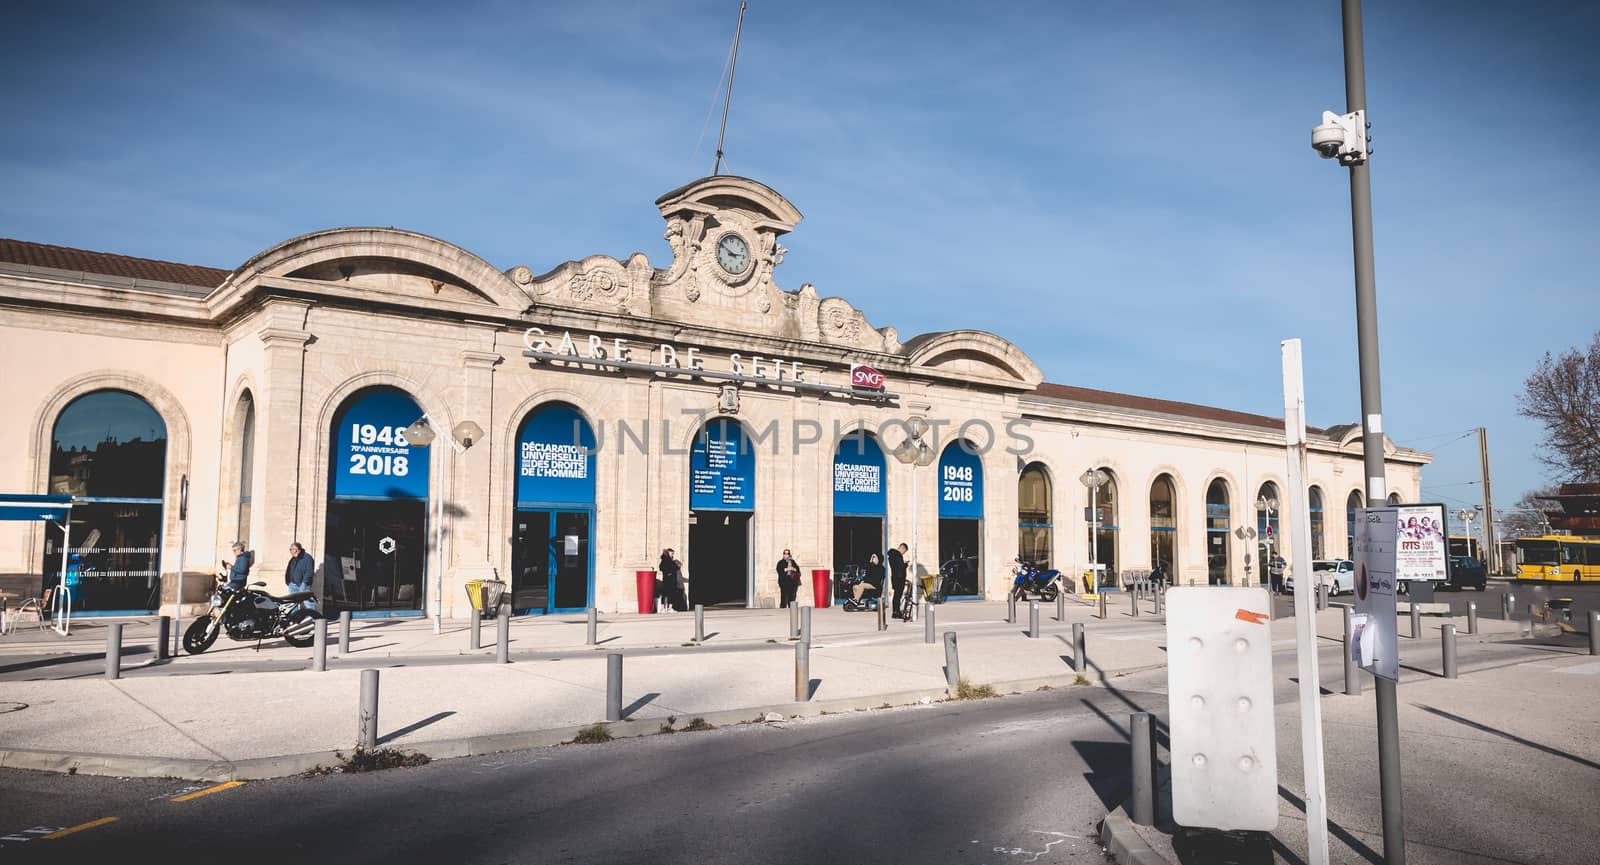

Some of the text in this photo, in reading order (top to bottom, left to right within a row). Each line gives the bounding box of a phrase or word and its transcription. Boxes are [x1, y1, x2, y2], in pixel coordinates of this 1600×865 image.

[523, 327, 628, 361] GARE
[660, 343, 701, 370] DE
[855, 371, 884, 386] SNCF
[352, 423, 409, 447] 1948
[522, 451, 585, 463] UNIVERSELLE
[349, 453, 409, 477] 2018
[531, 459, 549, 469] DES
[551, 461, 584, 470] DROITS
[835, 462, 878, 473] DÉCLARATION
[522, 467, 535, 477] DE
[835, 470, 878, 479] UNIVERSELLE
[944, 465, 973, 481] 1948
[835, 484, 845, 492] DE
[944, 486, 973, 502] 2018
[1402, 541, 1421, 550] RTS
